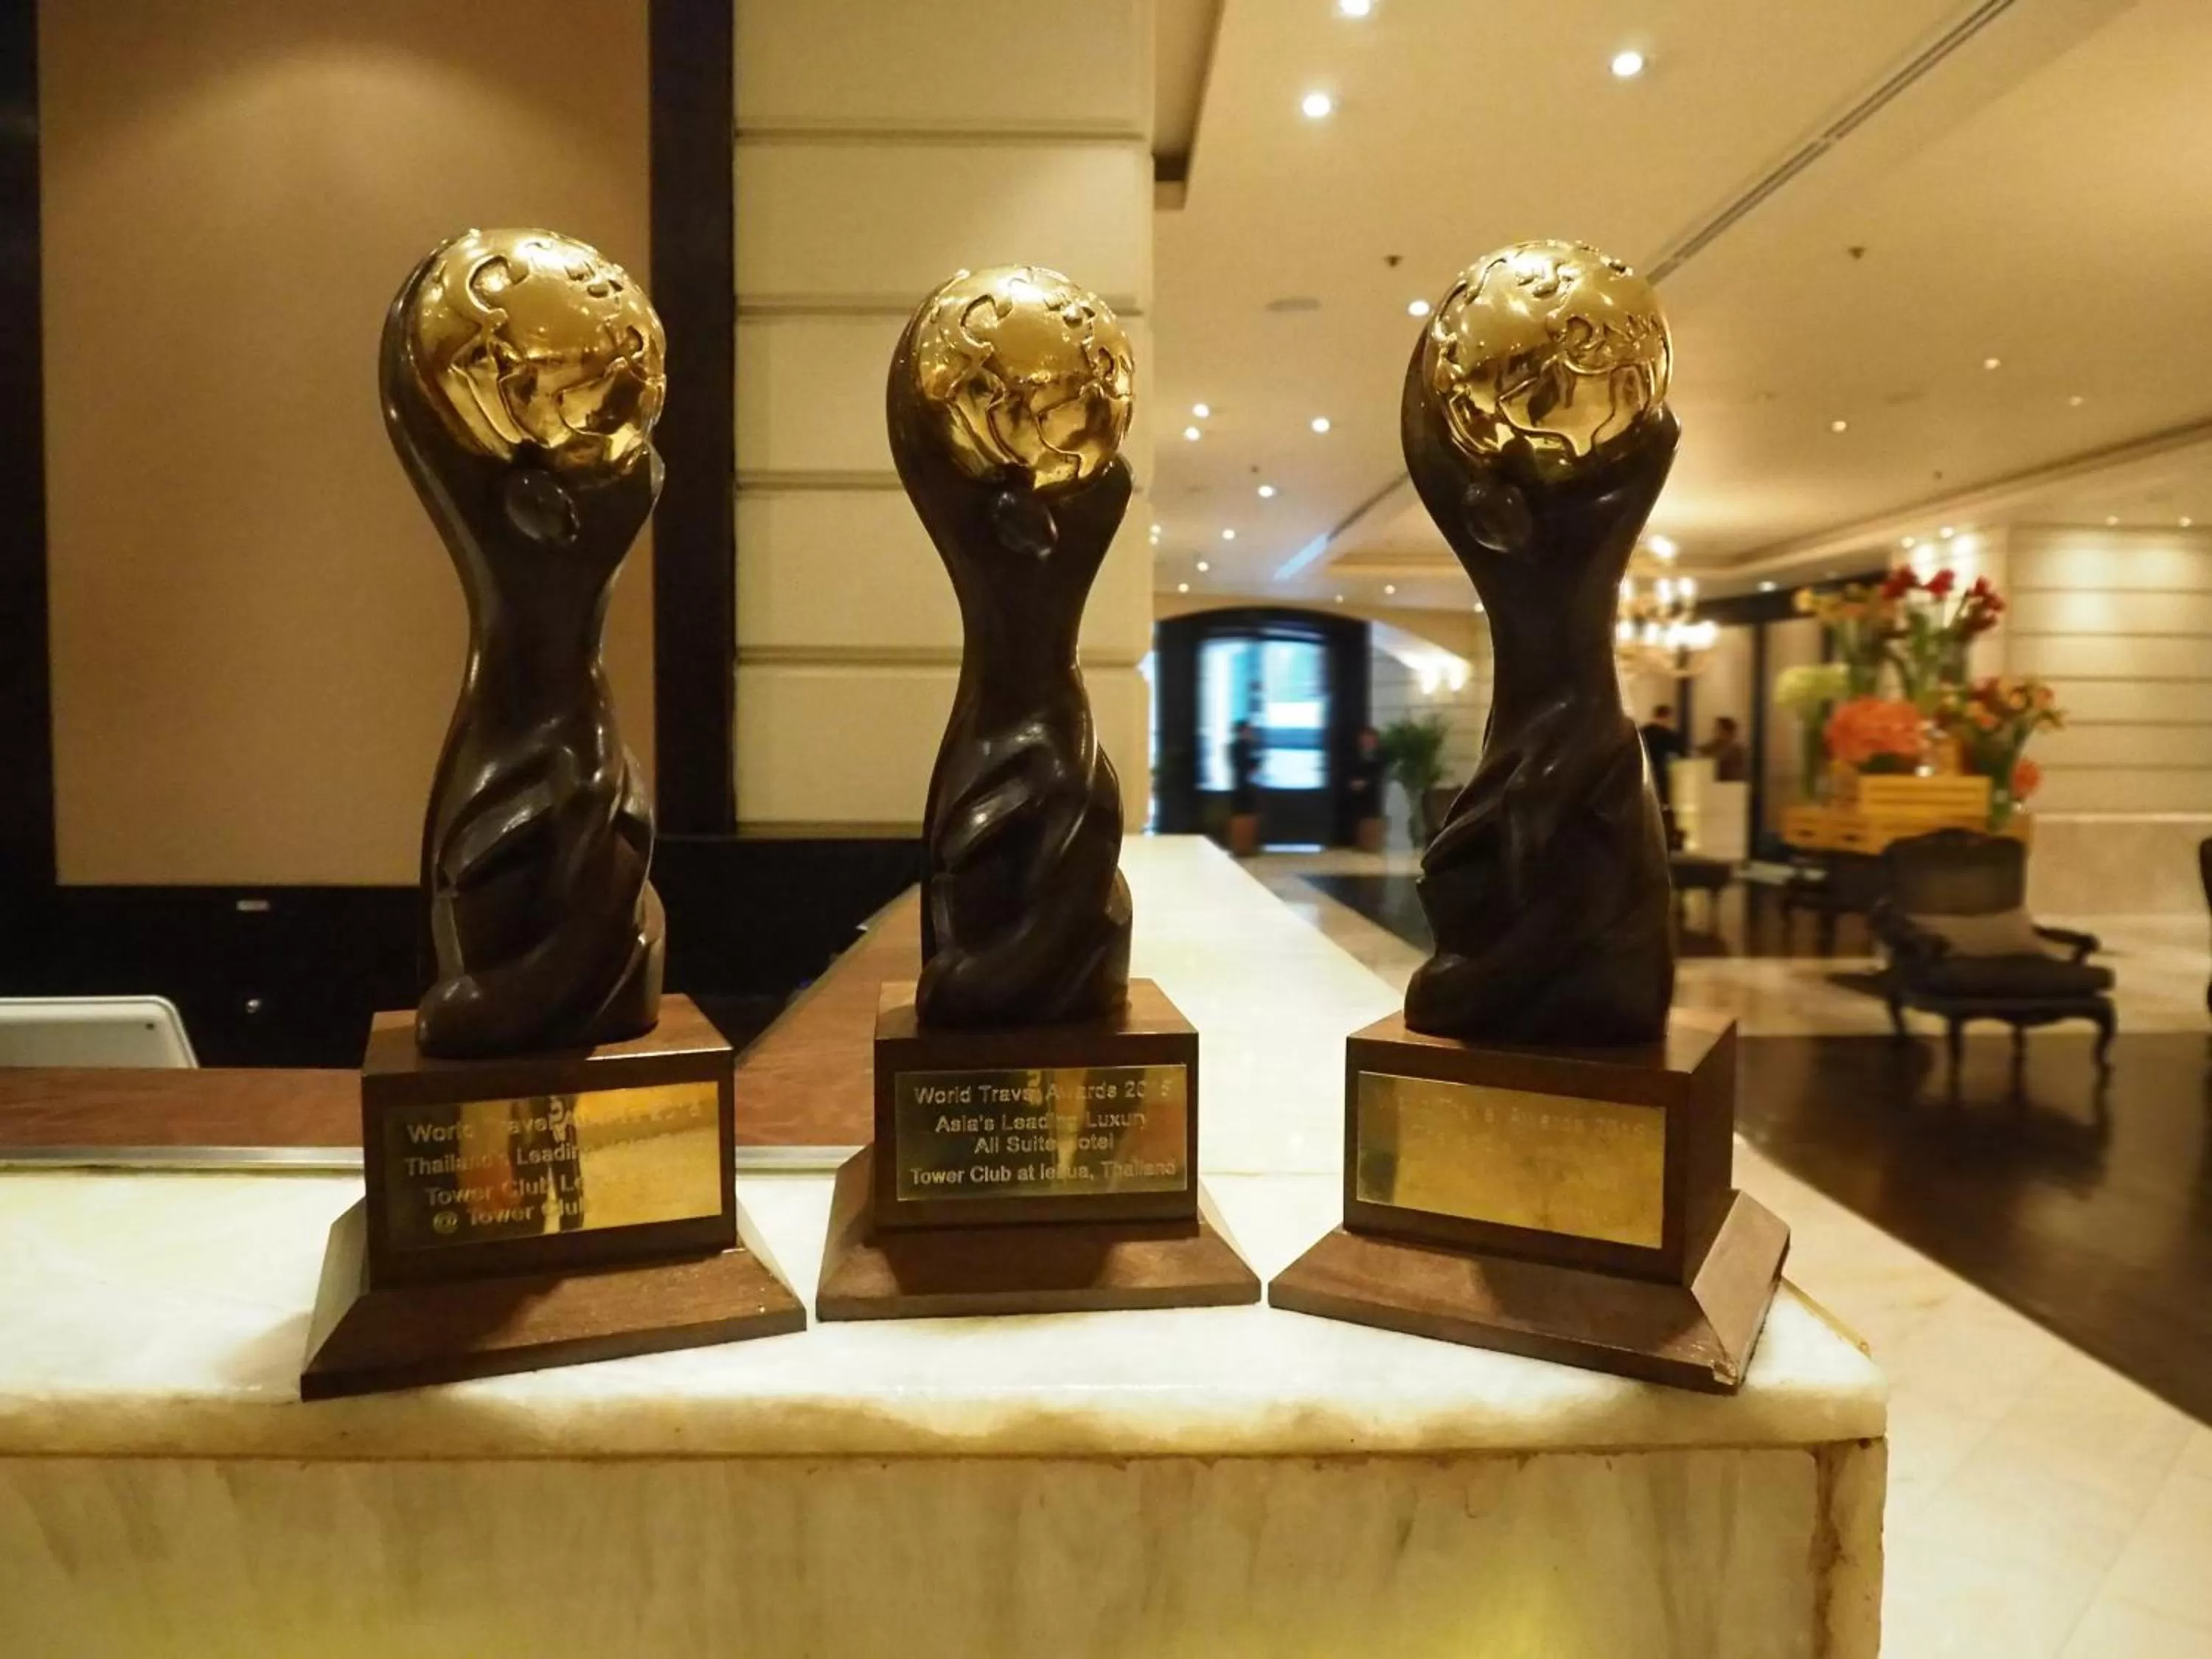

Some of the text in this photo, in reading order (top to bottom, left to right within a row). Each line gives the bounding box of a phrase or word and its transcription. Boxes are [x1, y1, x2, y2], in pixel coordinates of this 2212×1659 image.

[914, 1085, 972, 1105] World
[1046, 1080, 1118, 1102] Aards
[484, 1115, 552, 1135] avel
[935, 1110, 1148, 1133] Asia's Leadg Luxury
[517, 1143, 581, 1166] Leadi
[974, 1132, 1114, 1154] All Suite otel
[911, 1155, 1176, 1185] Tower Club at leua, Thailand
[425, 1184, 493, 1207] Tower
[502, 1175, 549, 1197] Club
[468, 1203, 534, 1225] Tower
